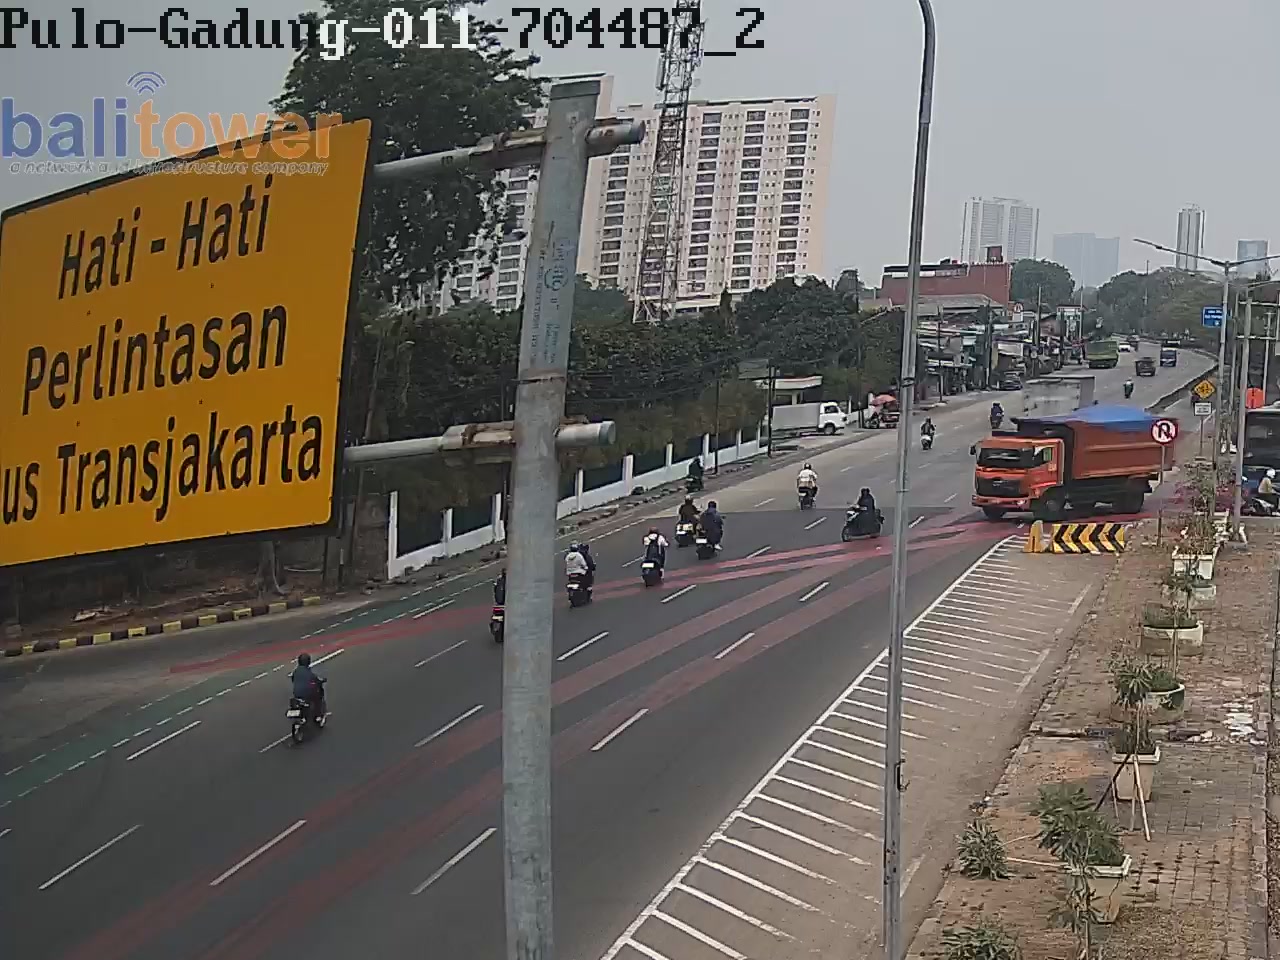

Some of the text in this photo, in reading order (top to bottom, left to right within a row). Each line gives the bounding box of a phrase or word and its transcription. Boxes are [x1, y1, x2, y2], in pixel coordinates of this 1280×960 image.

[58, 206, 141, 300] Hati
[177, 174, 273, 270] Hati
[22, 304, 287, 416] Perlintasan
[0, 404, 323, 525] us Transjakarta
